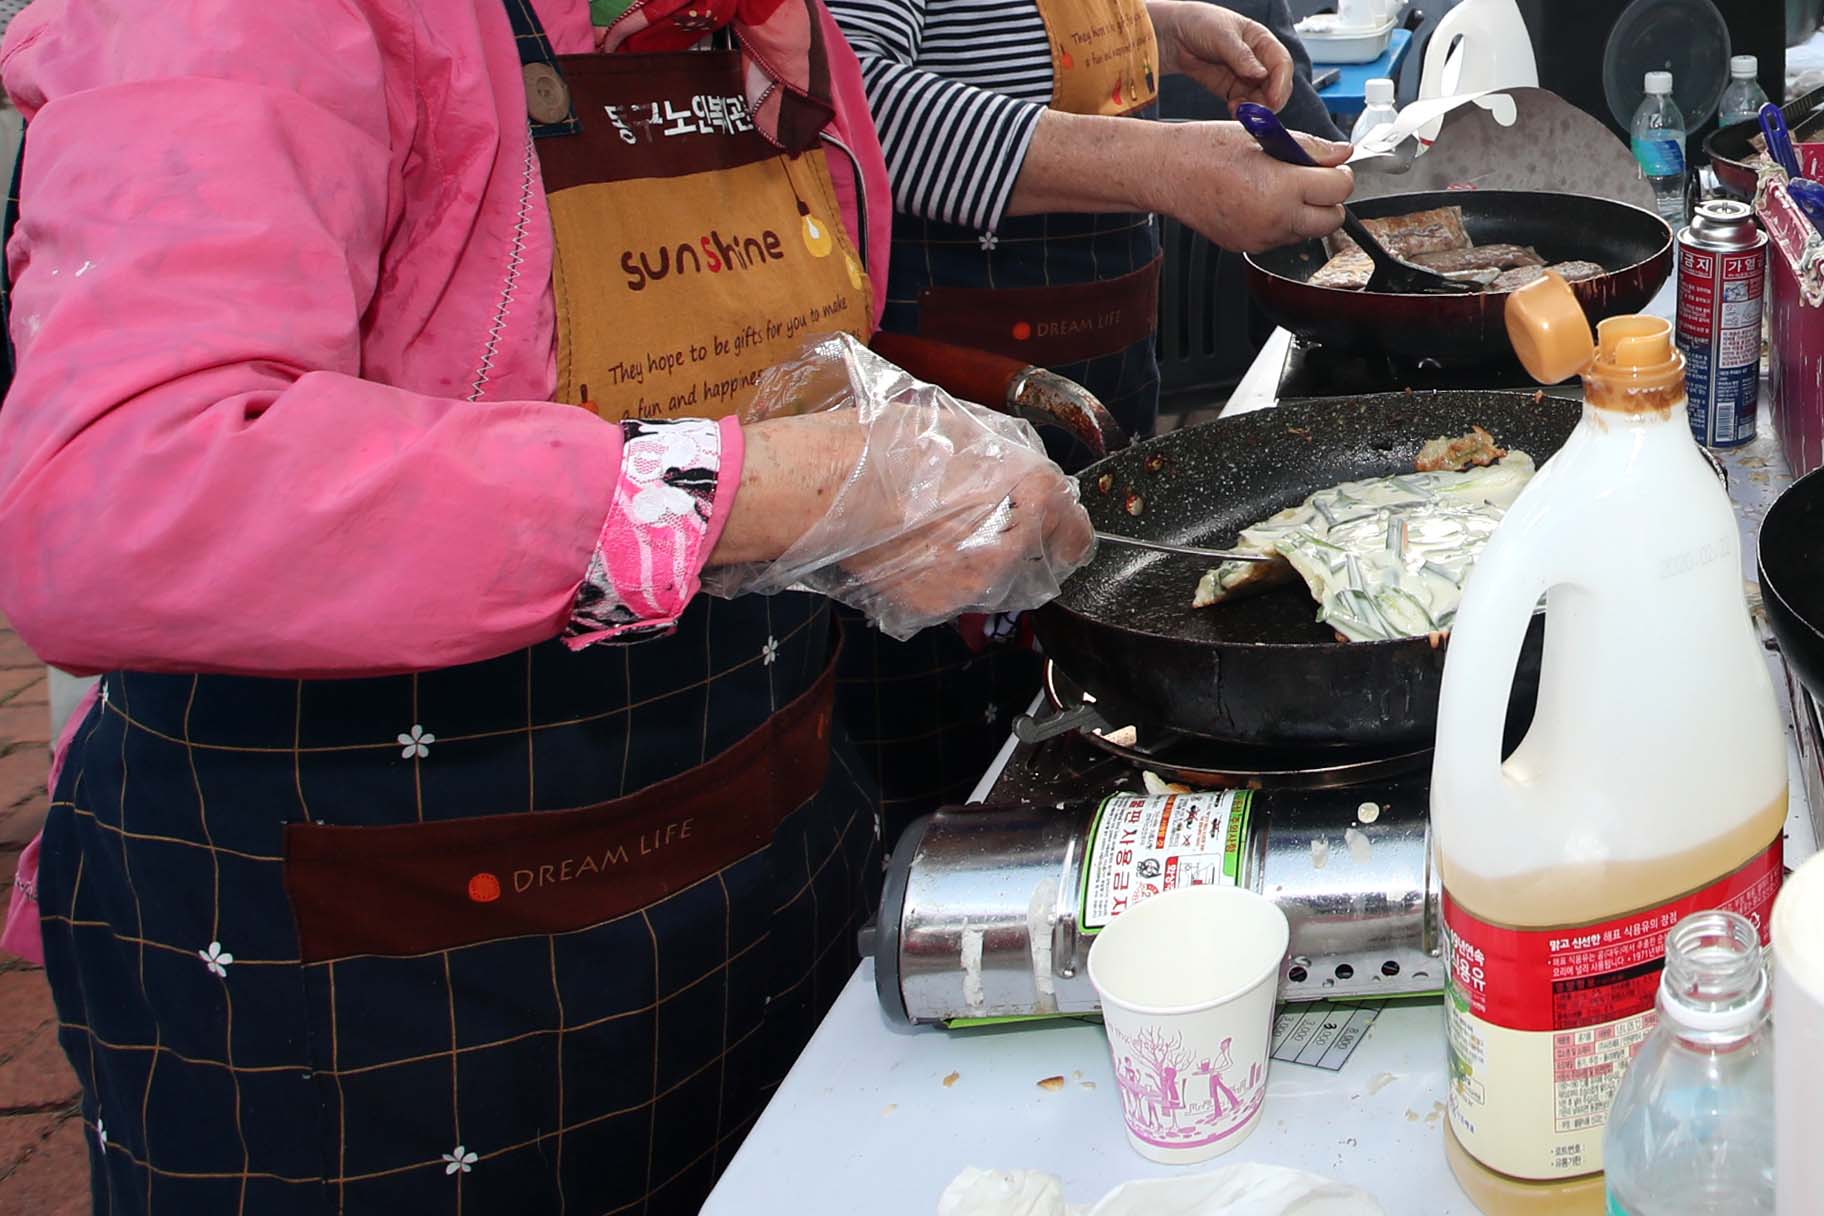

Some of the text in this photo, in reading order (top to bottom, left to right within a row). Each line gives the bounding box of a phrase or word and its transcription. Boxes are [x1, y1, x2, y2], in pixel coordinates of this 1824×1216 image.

[608, 295, 848, 386] They hope to be gifts for you to make
[637, 398, 662, 419] fun
[668, 385, 697, 409] and
[513, 818, 696, 894] DREAM LIFE
[1111, 828, 1138, 916] 사용금지
[1549, 912, 1678, 951] 맑고 신선한 해표 식용유의 장점
